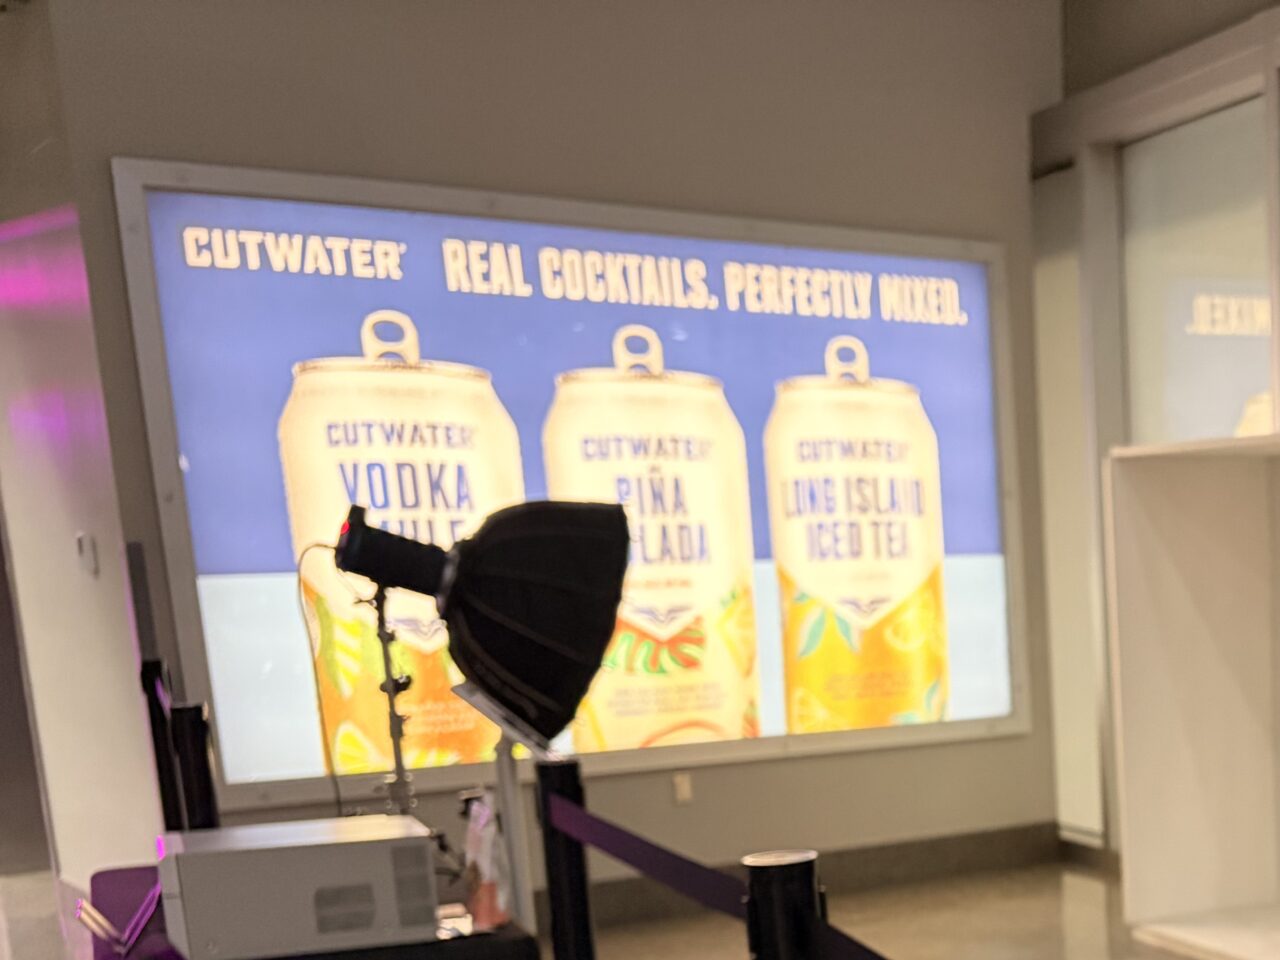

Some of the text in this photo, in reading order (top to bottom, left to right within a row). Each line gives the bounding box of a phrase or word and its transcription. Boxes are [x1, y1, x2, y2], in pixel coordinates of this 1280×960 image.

[183, 226, 406, 280] CUTWATER
[441, 237, 969, 327] REAL COCKTAILS. PERFECTLY MIXED.
[326, 420, 476, 448] CUTWATER
[339, 461, 475, 510] VODKA
[807, 522, 863, 561] ICED
